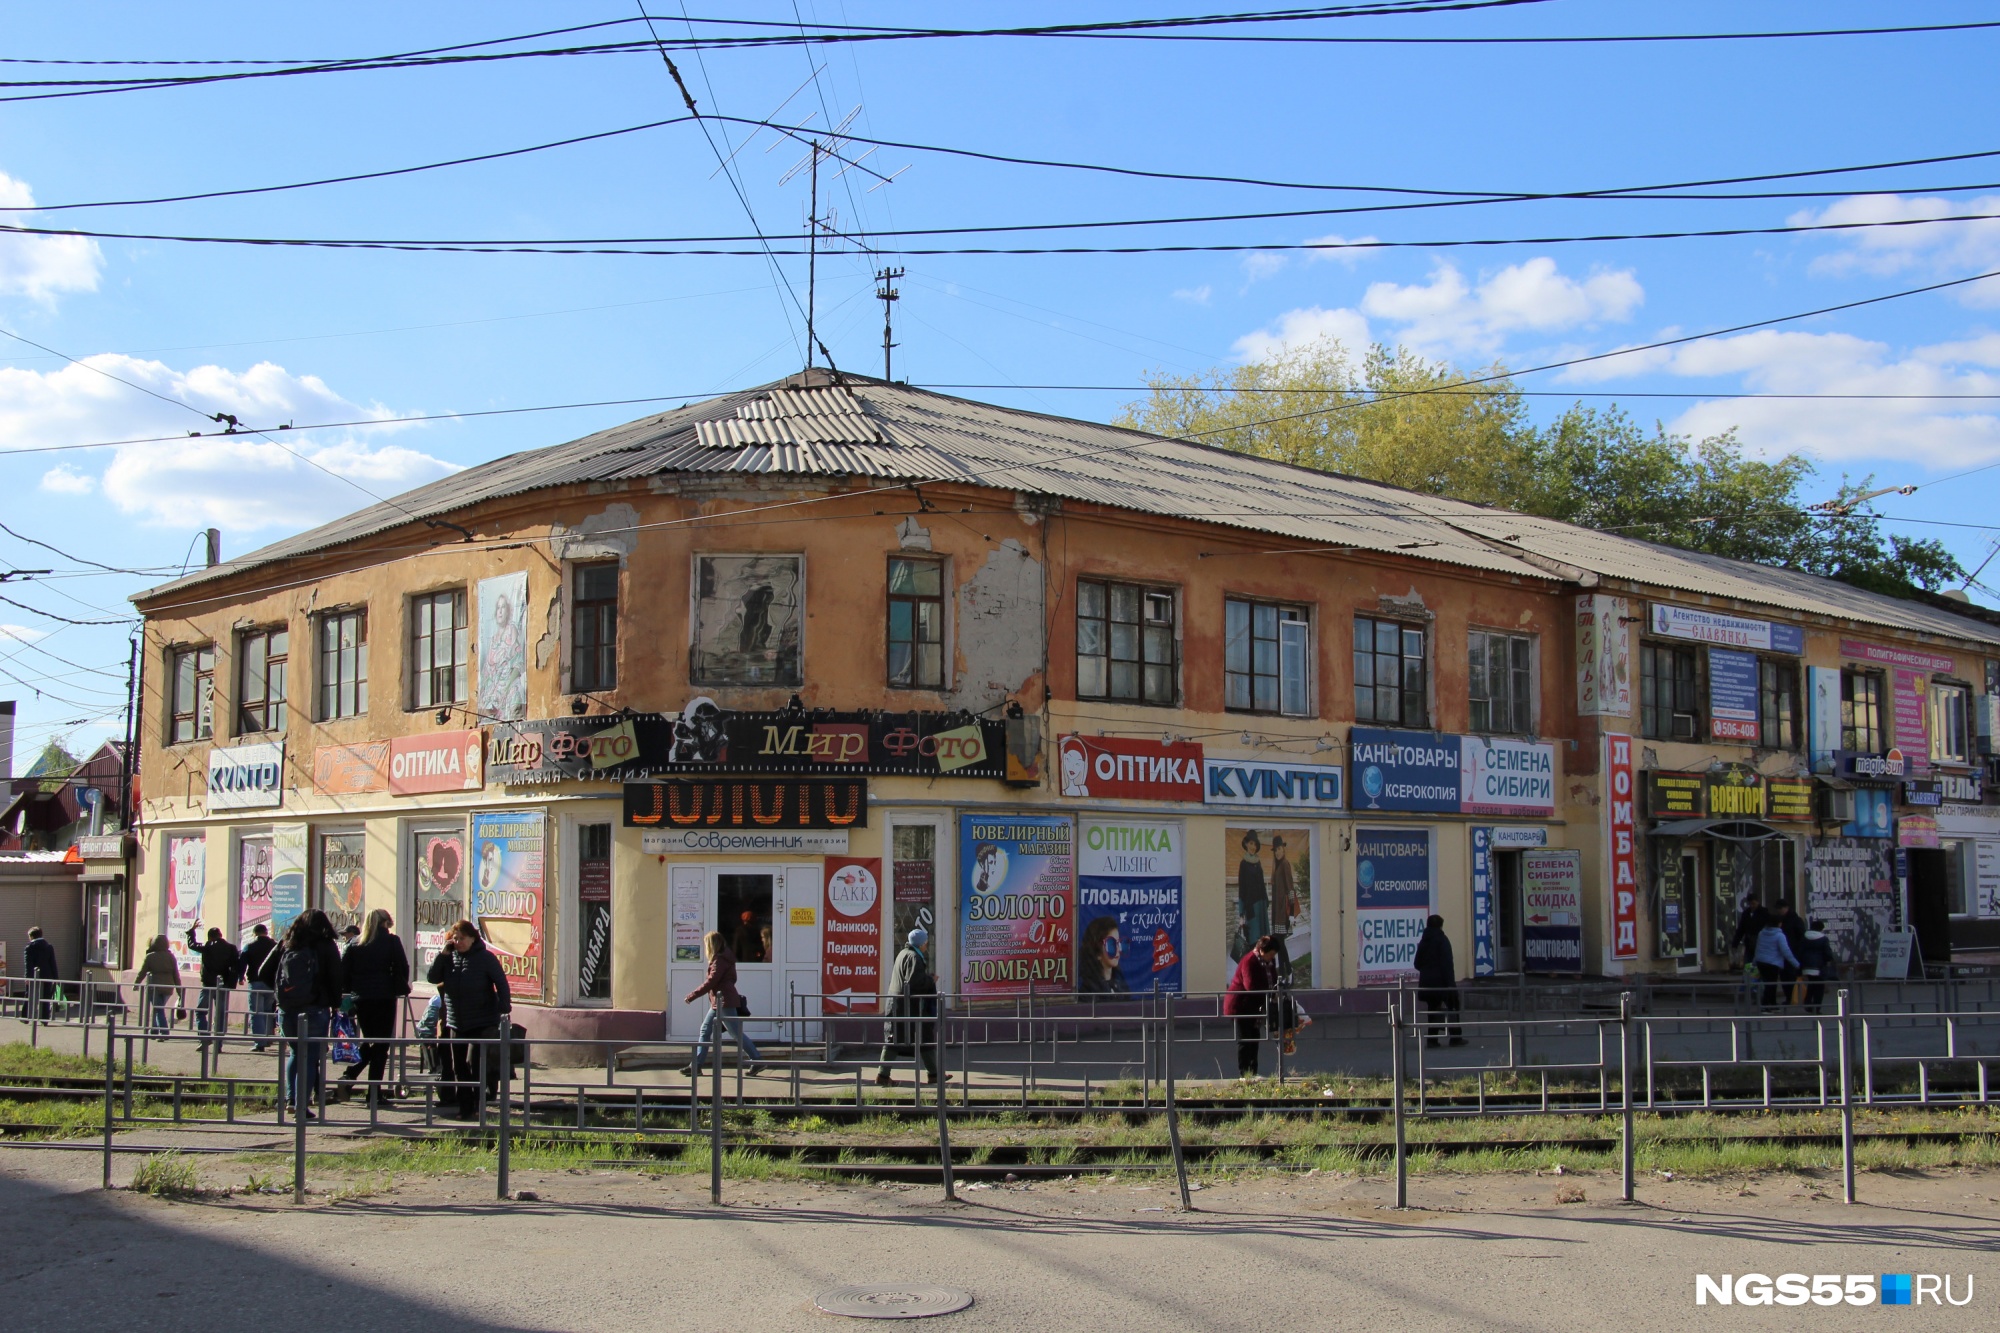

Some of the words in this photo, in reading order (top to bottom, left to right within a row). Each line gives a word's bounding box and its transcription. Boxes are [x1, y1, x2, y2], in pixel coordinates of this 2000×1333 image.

[1672, 608, 1711, 625] Агентство
[1712, 617, 1766, 633] недвижимости
[1692, 625, 1748, 646] СЛАВЯНКА
[1867, 647, 1931, 668] ПОЛИГРАФИЧЕСКИЙ
[1931, 658, 1952, 670] ЦЕНТР
[1722, 721, 1755, 738] 506-408
[489, 736, 542, 770] Мир
[549, 730, 632, 760] Фото
[758, 725, 865, 762] Мир
[883, 727, 981, 760] Фото
[392, 748, 461, 779] ОПТИКА
[1353, 744, 1459, 769] КАНЦТОВАРЫ
[1485, 748, 1551, 774] СЕМЕНА
[1095, 752, 1201, 785] ОПТИКА
[1856, 755, 1885, 778] magic
[1885, 759, 1904, 776] sun
[208, 763, 280, 793] KVINTO
[506, 769, 562, 786] МАГАЗИН
[577, 767, 650, 783] СТУДИЯ
[1209, 766, 1340, 800] KVINTO
[1385, 783, 1457, 801] КСЕРОКОПИЯ
[1485, 774, 1551, 799] СИБИРИ
[1710, 784, 1765, 815] ВОЕНТОРГ
[479, 819, 542, 839] ЮВЕЛИРНЫЙ
[971, 823, 1071, 842] ЮВЕЛИРНЫЙ
[80, 842, 102, 853] РЕМОНТ
[102, 841, 121, 853] ОБУВИ
[273, 831, 304, 849] ОПТИКА
[325, 837, 342, 853] Ваш
[507, 840, 542, 853] МАГАЗИН
[1086, 825, 1172, 853] ОПТИКА
[1612, 740, 1636, 950] ЛОМБАРД
[1018, 842, 1071, 855] МАГАЗИН
[1356, 842, 1428, 859] КАНЦТОВАРЫ
[1048, 865, 1070, 874] Скидки
[1050, 857, 1070, 865] Обмен
[1102, 855, 1158, 873] АЛЬЯНС
[1527, 860, 1574, 869] СЕМЕНА
[178, 869, 200, 885] LAKKI
[324, 871, 349, 888] выбор
[1039, 874, 1070, 884] Рассрочка
[1527, 871, 1574, 880] СИБИРИ
[1812, 866, 1871, 893] ВОЕНТОРГ
[832, 885, 875, 902] LAKKI
[1032, 882, 1070, 892] Распродажа
[1374, 880, 1428, 892] КСЕРОКОПИЯ
[1474, 829, 1488, 959] СЕМЕНА
[477, 890, 537, 916] ЗОЛОТО
[1080, 888, 1178, 906] ГЛОБАЛЬНЫЕ
[1527, 893, 1577, 908] СКИДКА
[969, 894, 1066, 921] ЗОЛОТО
[827, 919, 878, 935] Маникюр,
[965, 924, 989, 932] Высокая
[990, 925, 1011, 933] оценка
[1362, 919, 1425, 939] СЕМЕНА
[987, 932, 1013, 941] процент
[1008, 941, 1022, 949] срок
[1131, 934, 1154, 943] оправы
[579, 906, 611, 997] ЛОМБАРД
[826, 941, 878, 958] Педикюр,
[965, 948, 976, 957] Все
[1155, 951, 1175, 966] -50%
[826, 962, 853, 976] Гель
[855, 964, 877, 976] лак.
[964, 958, 1068, 984] ЛОМБАРД
